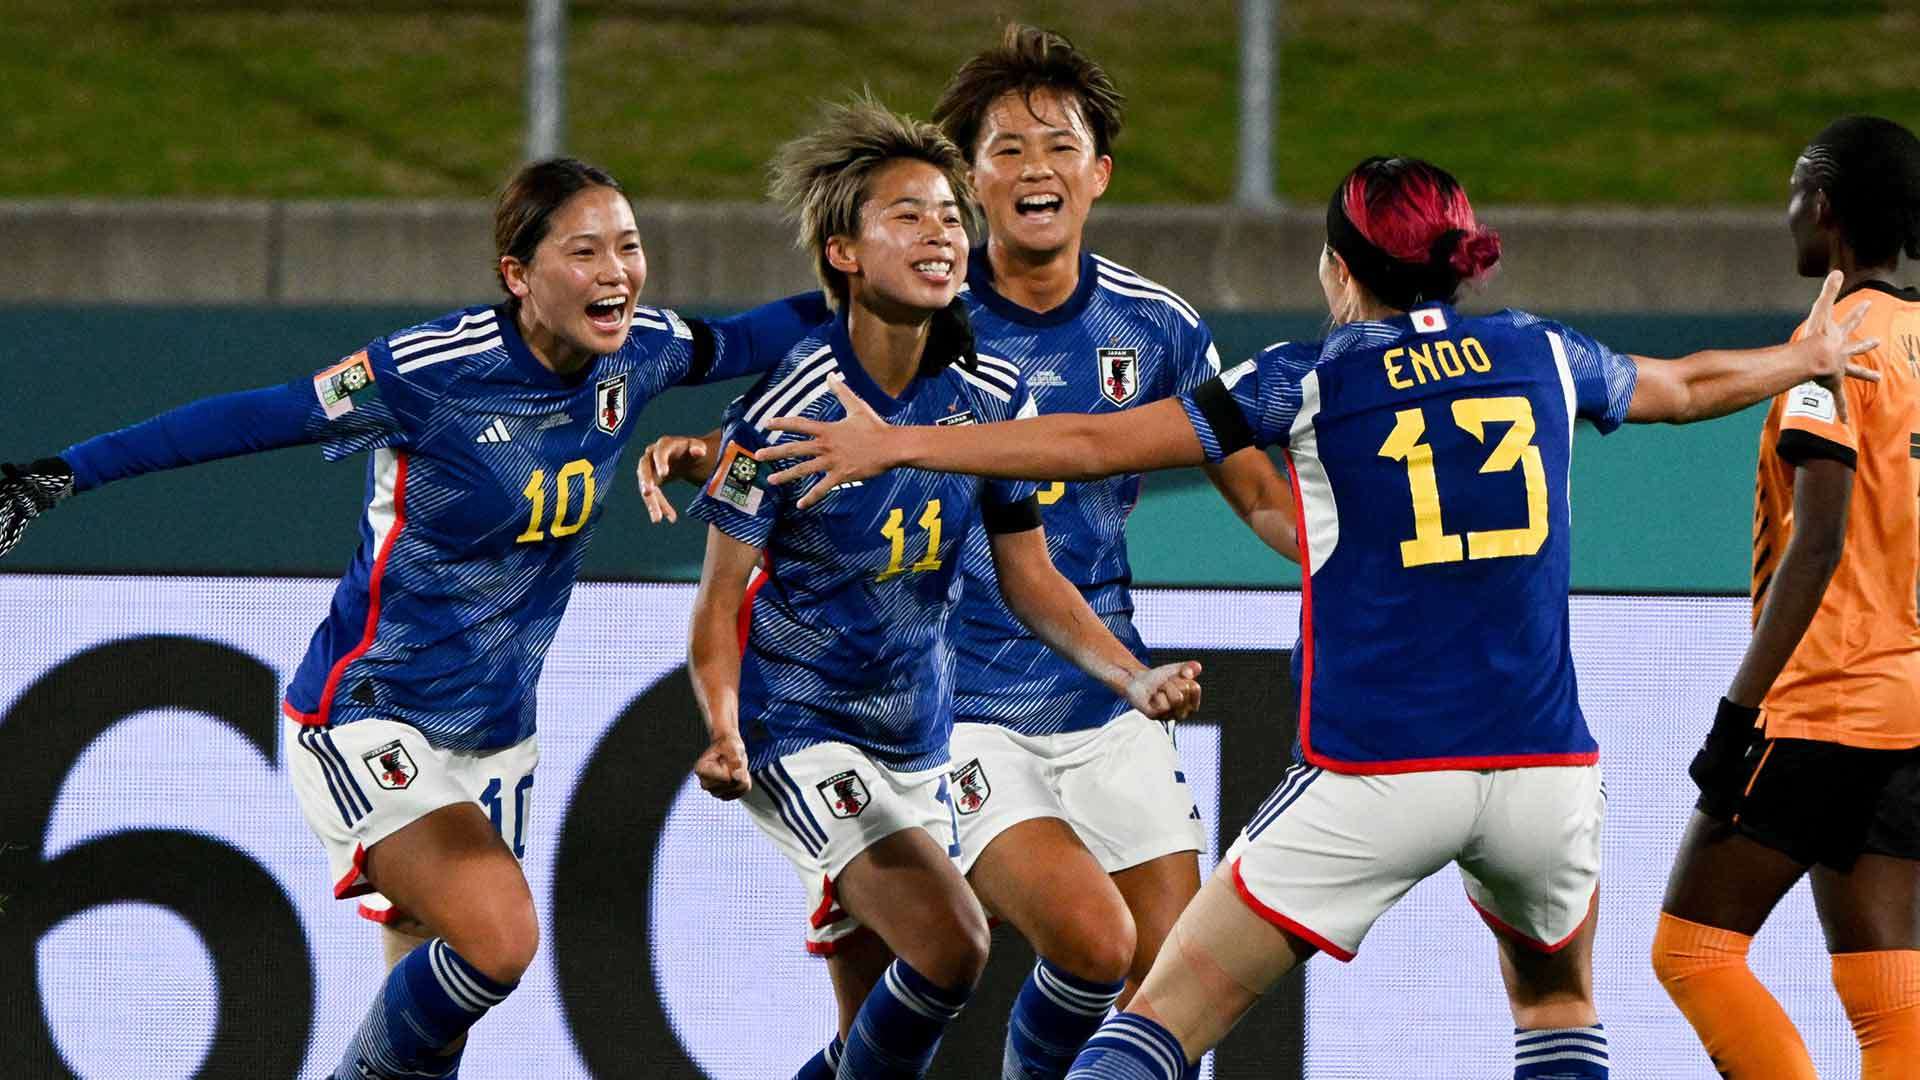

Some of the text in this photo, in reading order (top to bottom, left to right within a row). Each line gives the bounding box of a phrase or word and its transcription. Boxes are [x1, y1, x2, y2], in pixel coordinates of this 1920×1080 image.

[1383, 337, 1493, 390] ENDO
[516, 458, 597, 544] 10
[1377, 396, 1550, 568] 13
[876, 498, 943, 583] 11
